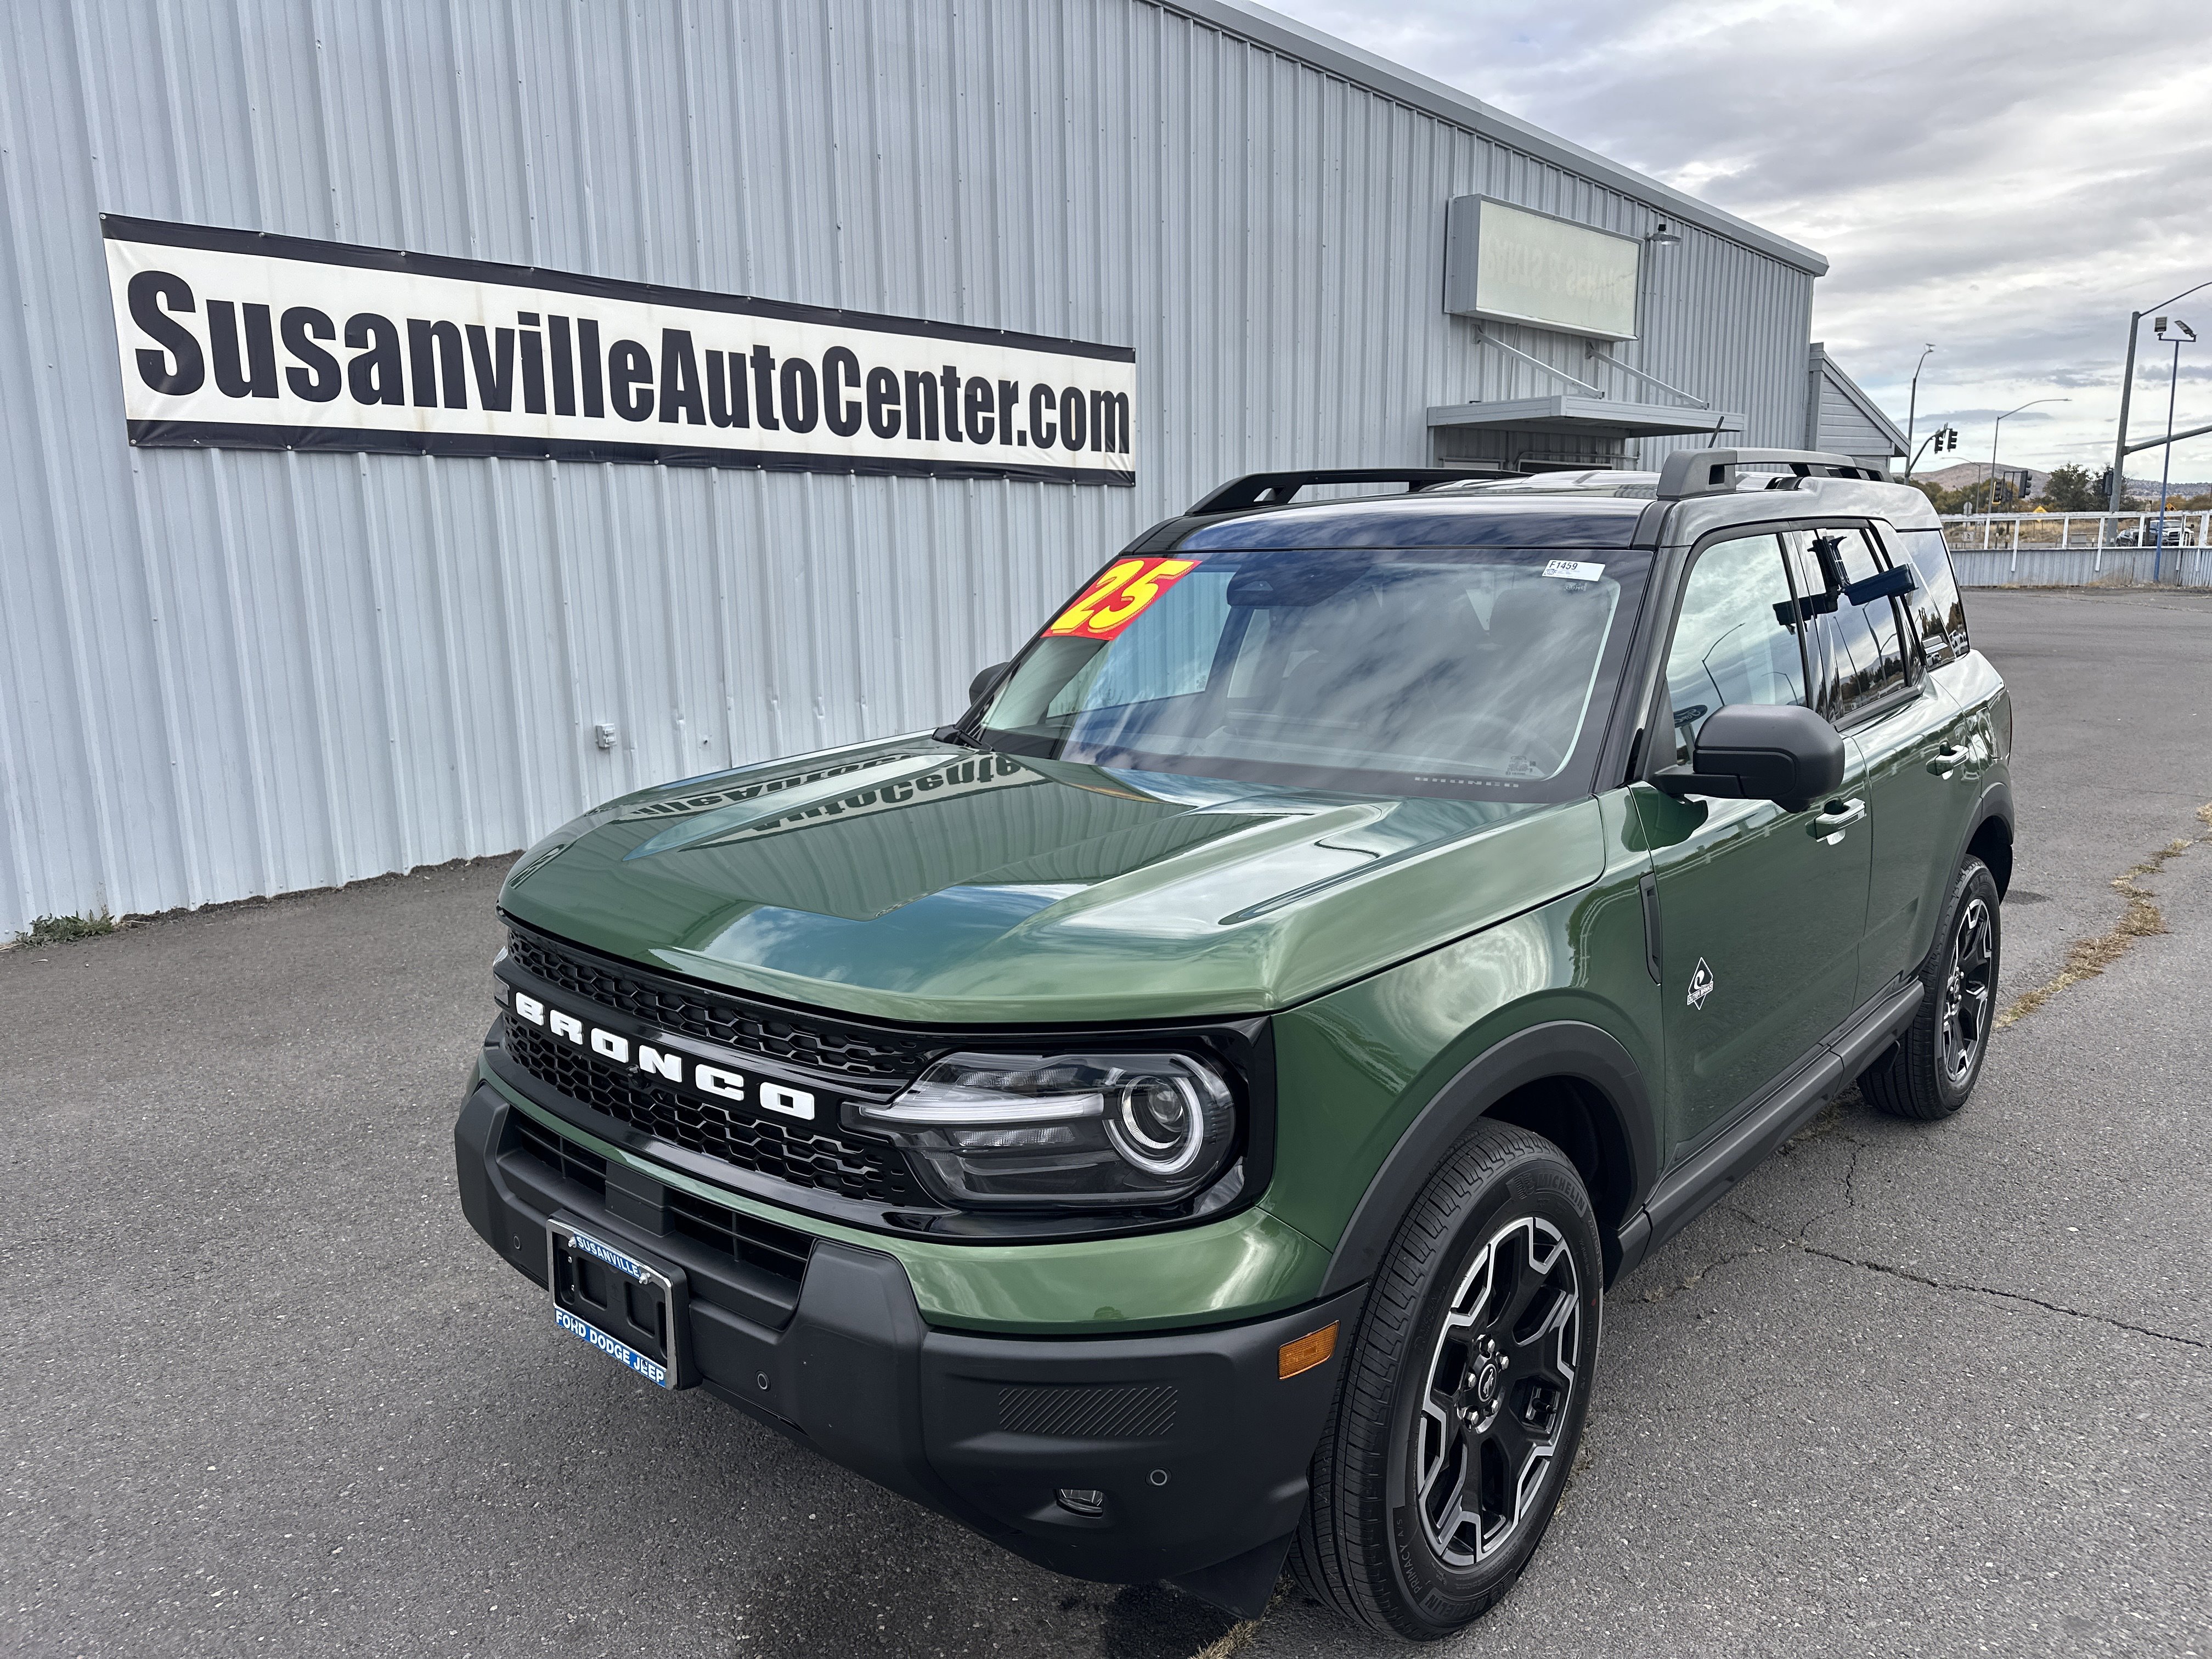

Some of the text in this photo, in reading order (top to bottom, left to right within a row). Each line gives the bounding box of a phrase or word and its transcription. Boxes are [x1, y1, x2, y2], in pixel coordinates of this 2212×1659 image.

[127, 270, 1130, 455] SusanvilleAutoCenter.com
[1549, 561, 1578, 570] F1459
[1051, 560, 1194, 634] 25
[515, 992, 815, 1120] BRONCO
[1537, 1172, 1585, 1212] MICHELIN
[577, 1236, 640, 1278] SUSANVILLE
[556, 1310, 664, 1383] FORD DODGE JEEP
[1400, 1544, 1423, 1594] PRIMACY
